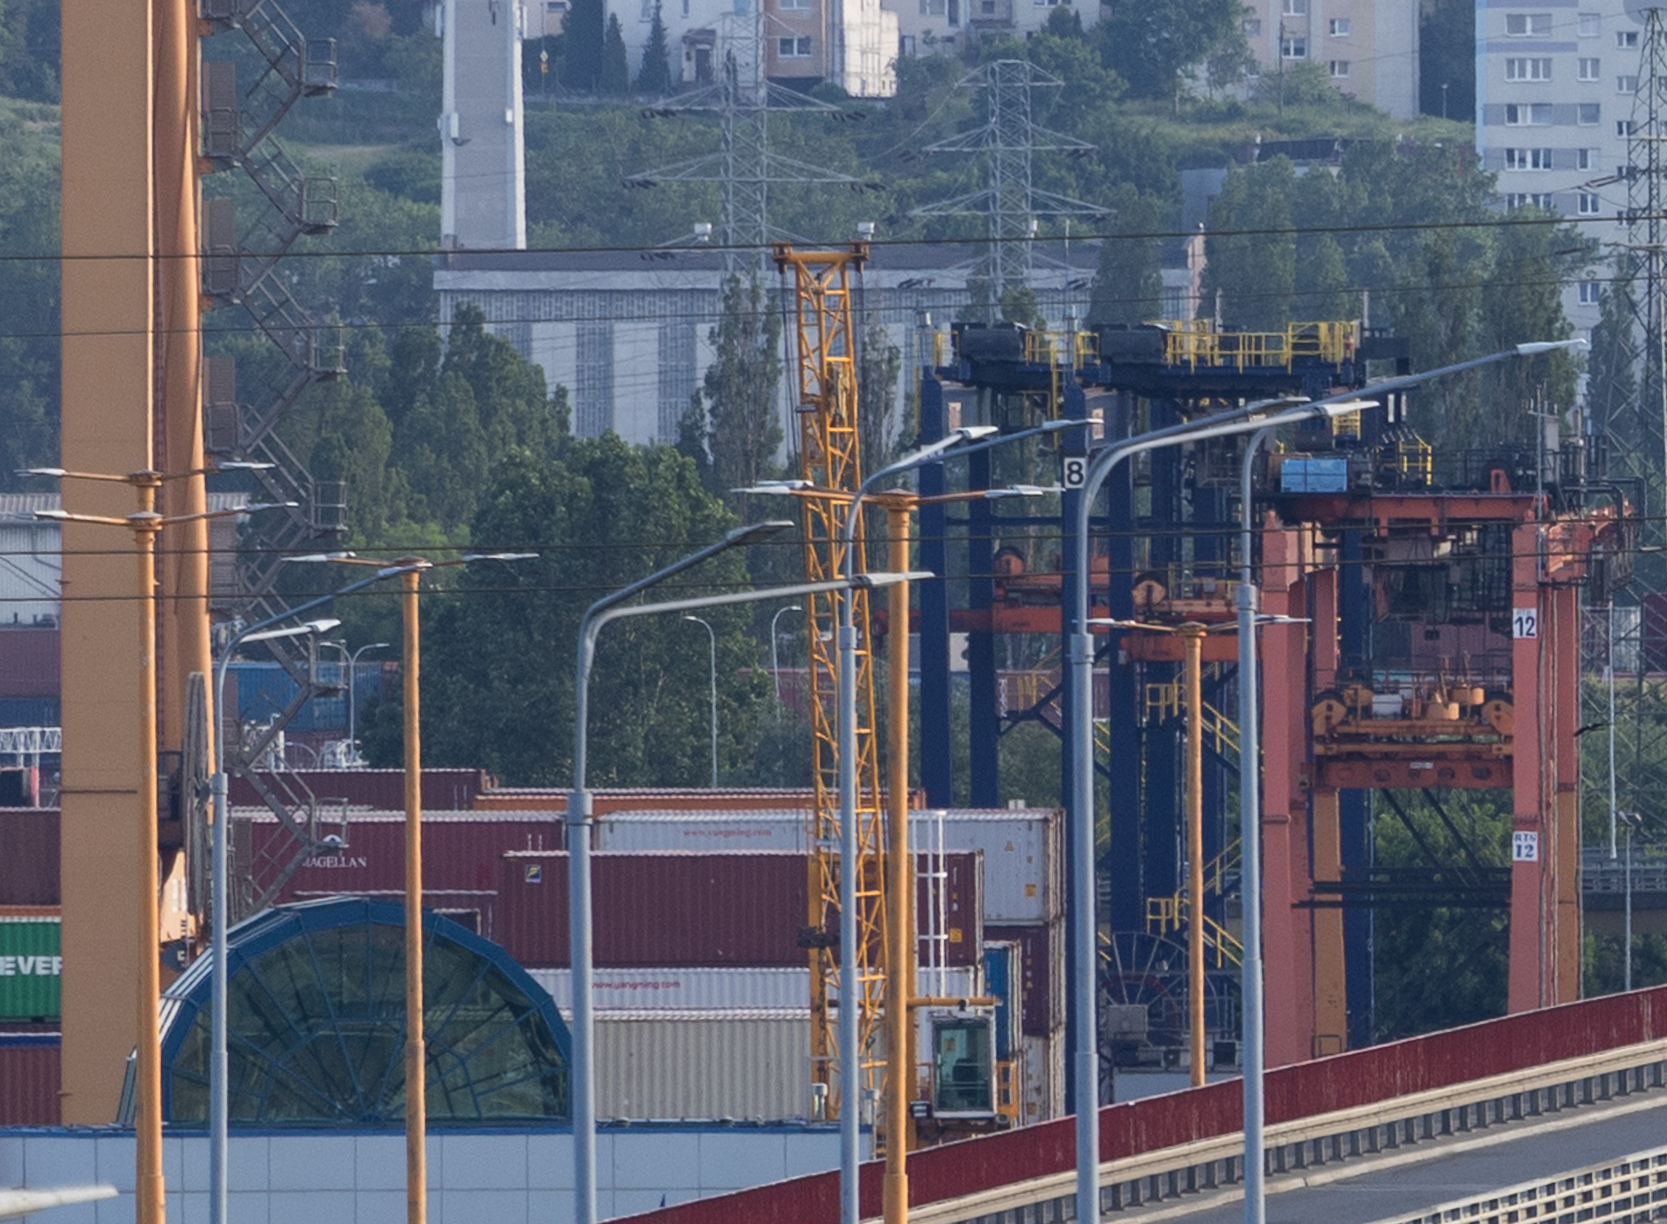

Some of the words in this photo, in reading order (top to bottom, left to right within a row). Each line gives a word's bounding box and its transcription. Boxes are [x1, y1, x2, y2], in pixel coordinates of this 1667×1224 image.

[1067, 461, 1083, 485] 8
[1515, 616, 1535, 636] 12
[1516, 845, 1534, 858] 12
